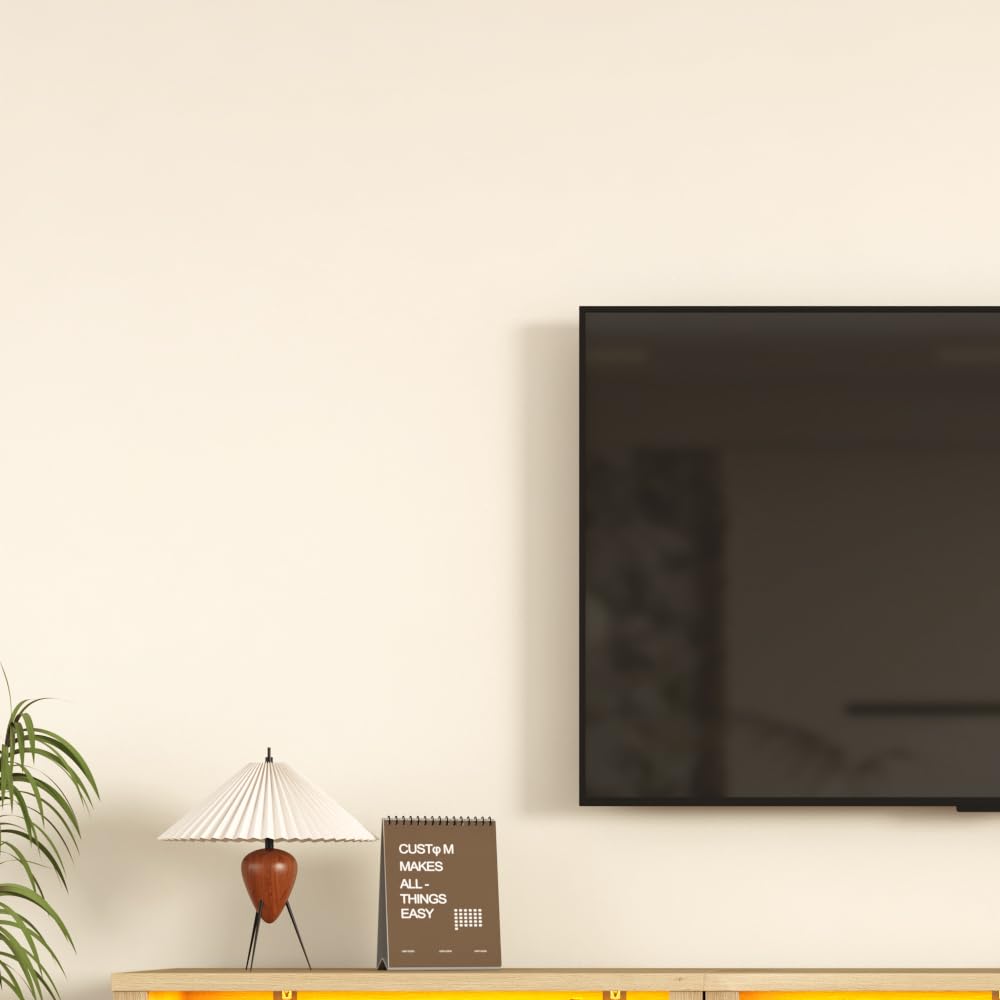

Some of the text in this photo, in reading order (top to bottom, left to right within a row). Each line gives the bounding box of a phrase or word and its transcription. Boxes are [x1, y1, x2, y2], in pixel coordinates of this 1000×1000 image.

[400, 861, 444, 871] MAKES
[400, 878, 422, 889] ALL
[400, 894, 447, 904] THINGS
[400, 908, 434, 919] EASY
